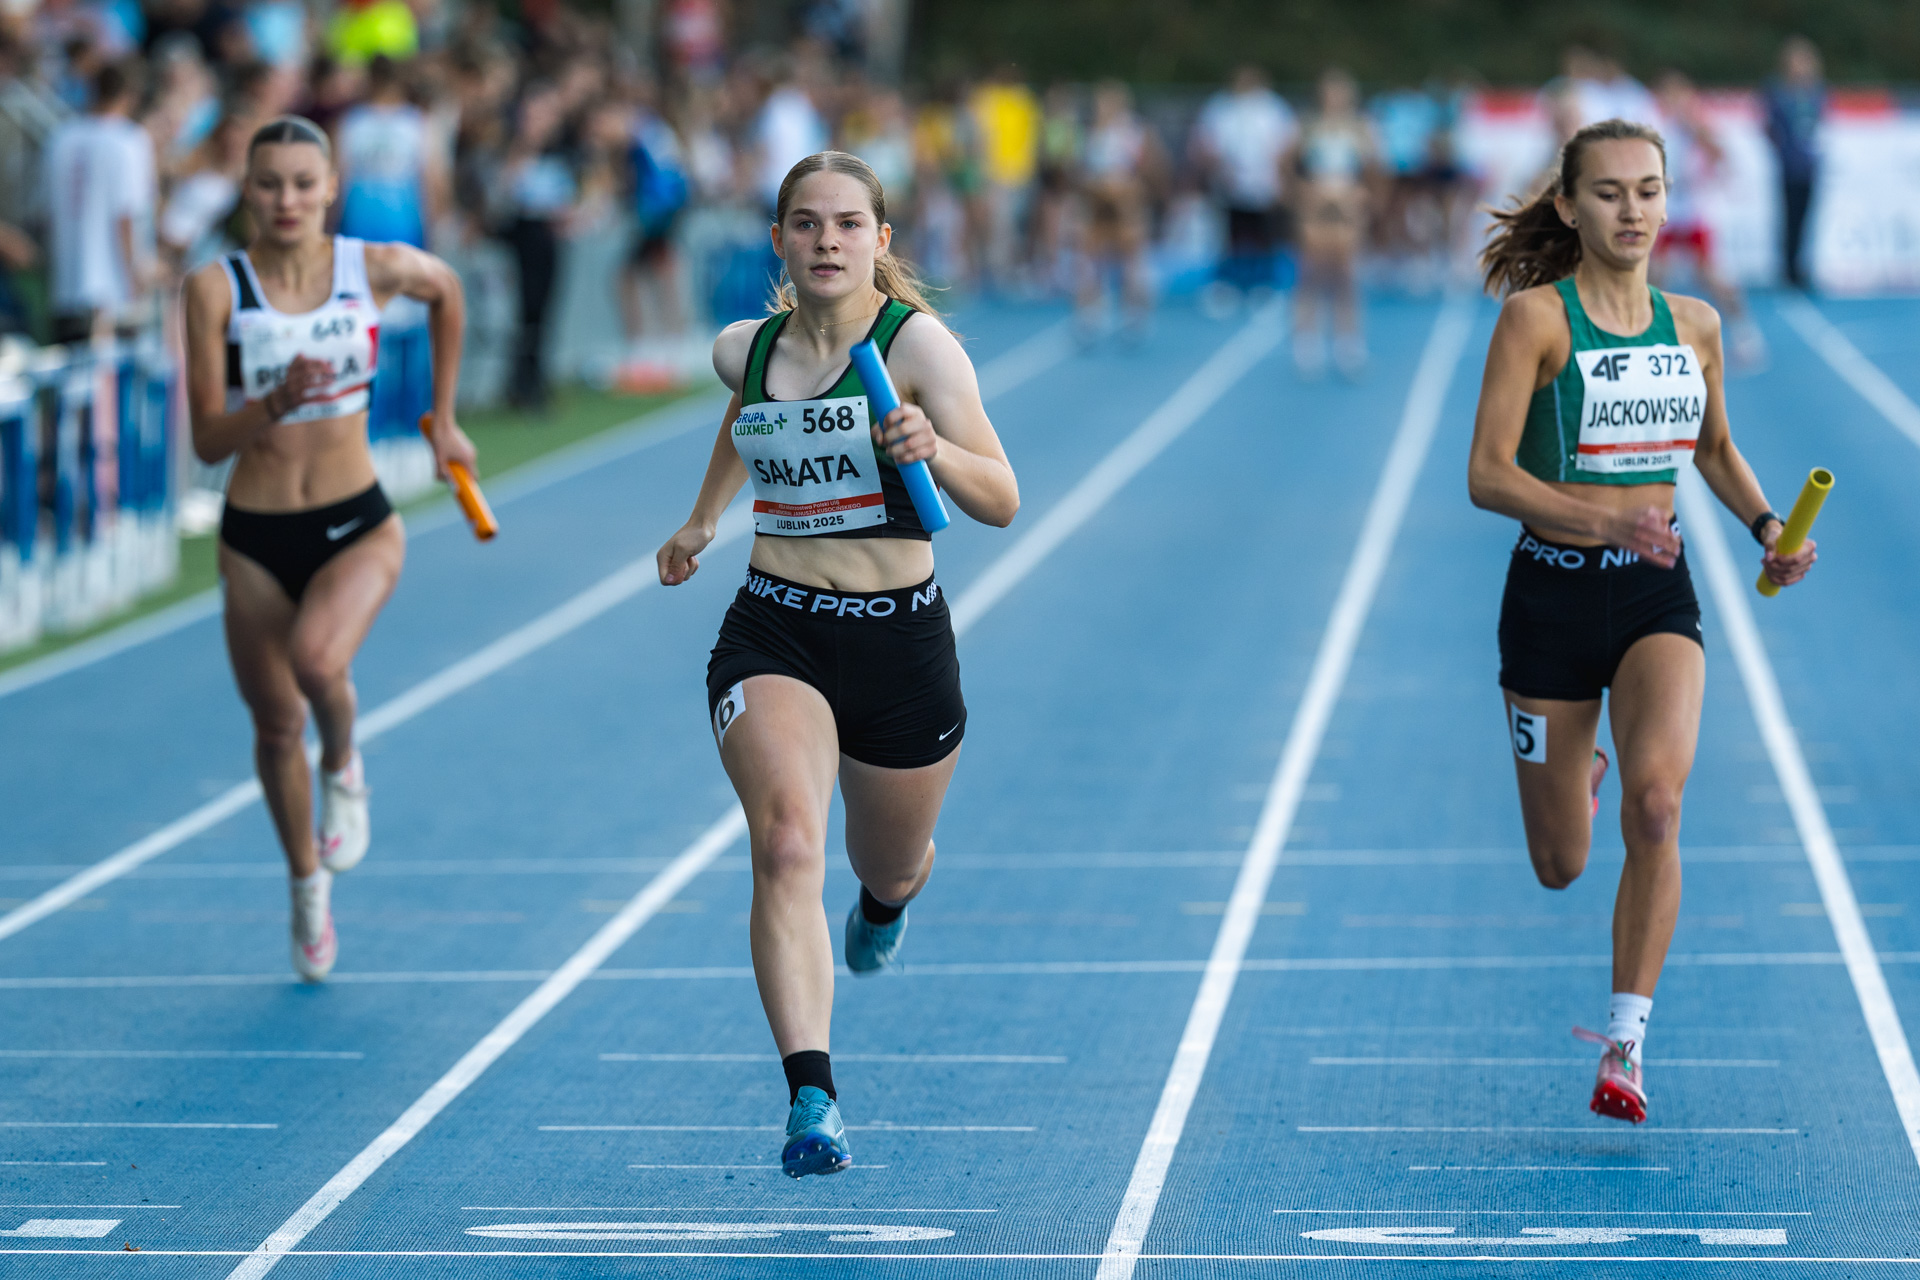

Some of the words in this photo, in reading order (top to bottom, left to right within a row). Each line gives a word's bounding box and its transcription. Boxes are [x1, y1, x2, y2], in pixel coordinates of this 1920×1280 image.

[1591, 353, 1630, 381] 4F
[1648, 353, 1690, 376] 372
[736, 411, 767, 424] GRUPA
[802, 405, 855, 434] 568
[1587, 396, 1700, 428] JACKOWSKA
[734, 423, 774, 436] LUXMED
[753, 454, 861, 487] SAŁATA
[1613, 455, 1648, 467] LUBLIN
[777, 519, 810, 530] LUBLIN
[813, 515, 845, 528] 2025
[1520, 535, 1586, 569] PRO
[746, 571, 809, 610] NIKE
[810, 593, 897, 618] PRO
[719, 690, 735, 731] 6
[1516, 713, 1535, 756] 5
